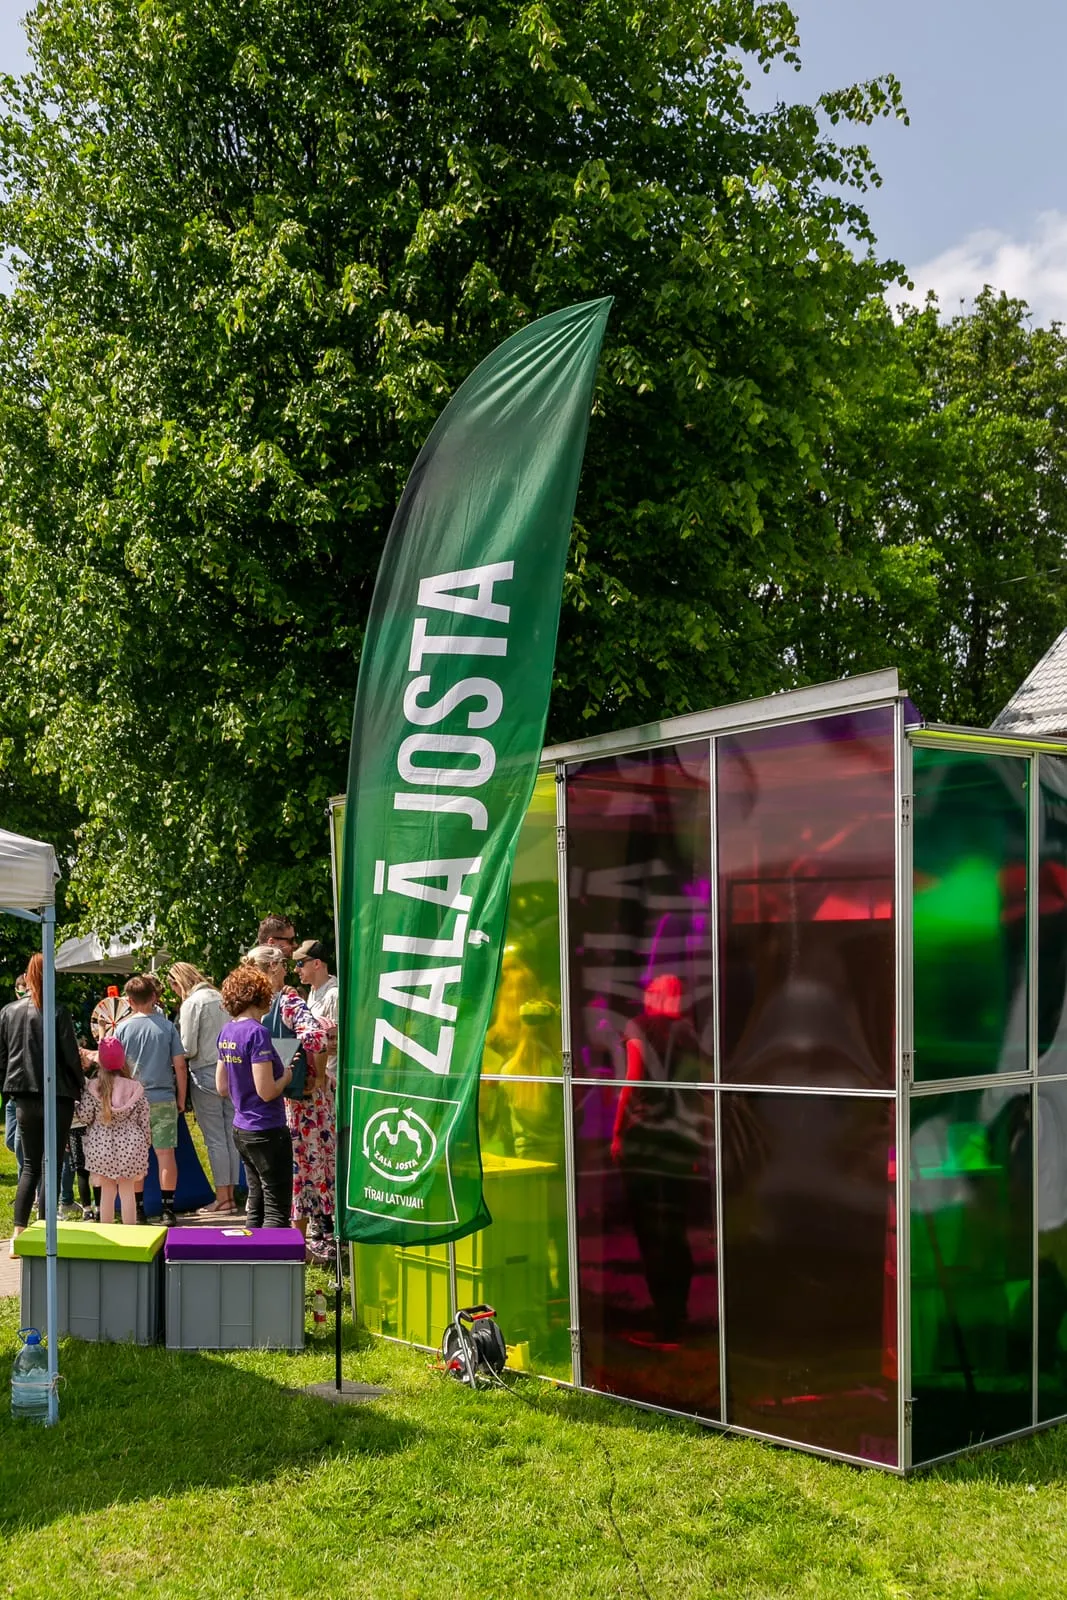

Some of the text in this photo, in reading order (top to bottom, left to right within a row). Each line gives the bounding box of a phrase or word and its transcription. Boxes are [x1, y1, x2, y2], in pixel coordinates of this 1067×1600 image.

[393, 560, 515, 831] JOSTA
[395, 1158, 419, 1170] JOSTA
[385, 1192, 425, 1209] LATVIJAI!
